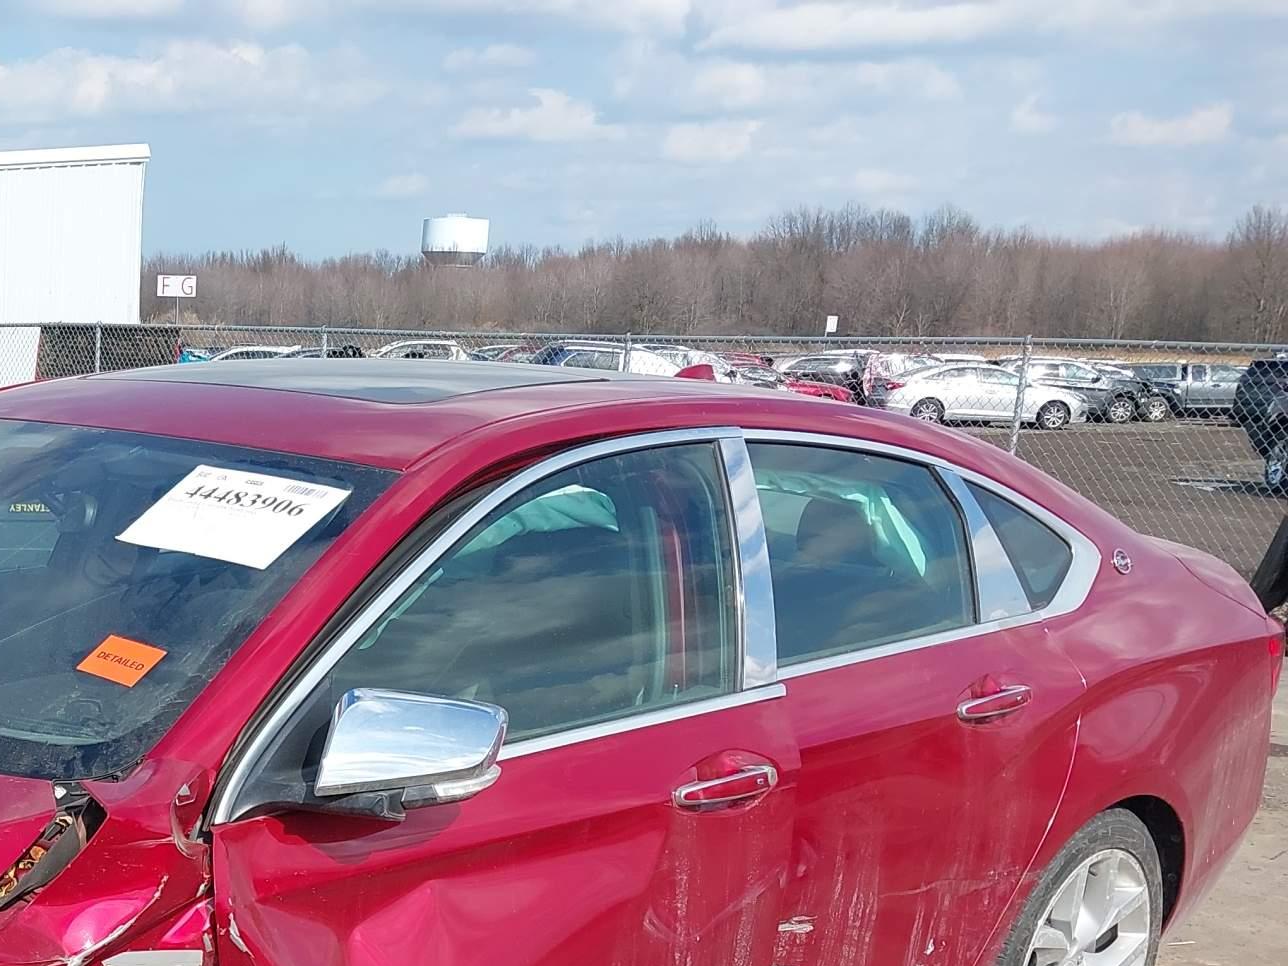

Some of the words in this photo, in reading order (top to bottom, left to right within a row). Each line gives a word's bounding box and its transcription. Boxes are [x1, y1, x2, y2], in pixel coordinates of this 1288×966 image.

[162, 276, 170, 295] F
[181, 276, 193, 295] G
[185, 485, 306, 517] 44483906
[96, 651, 145, 671] DETAILED
